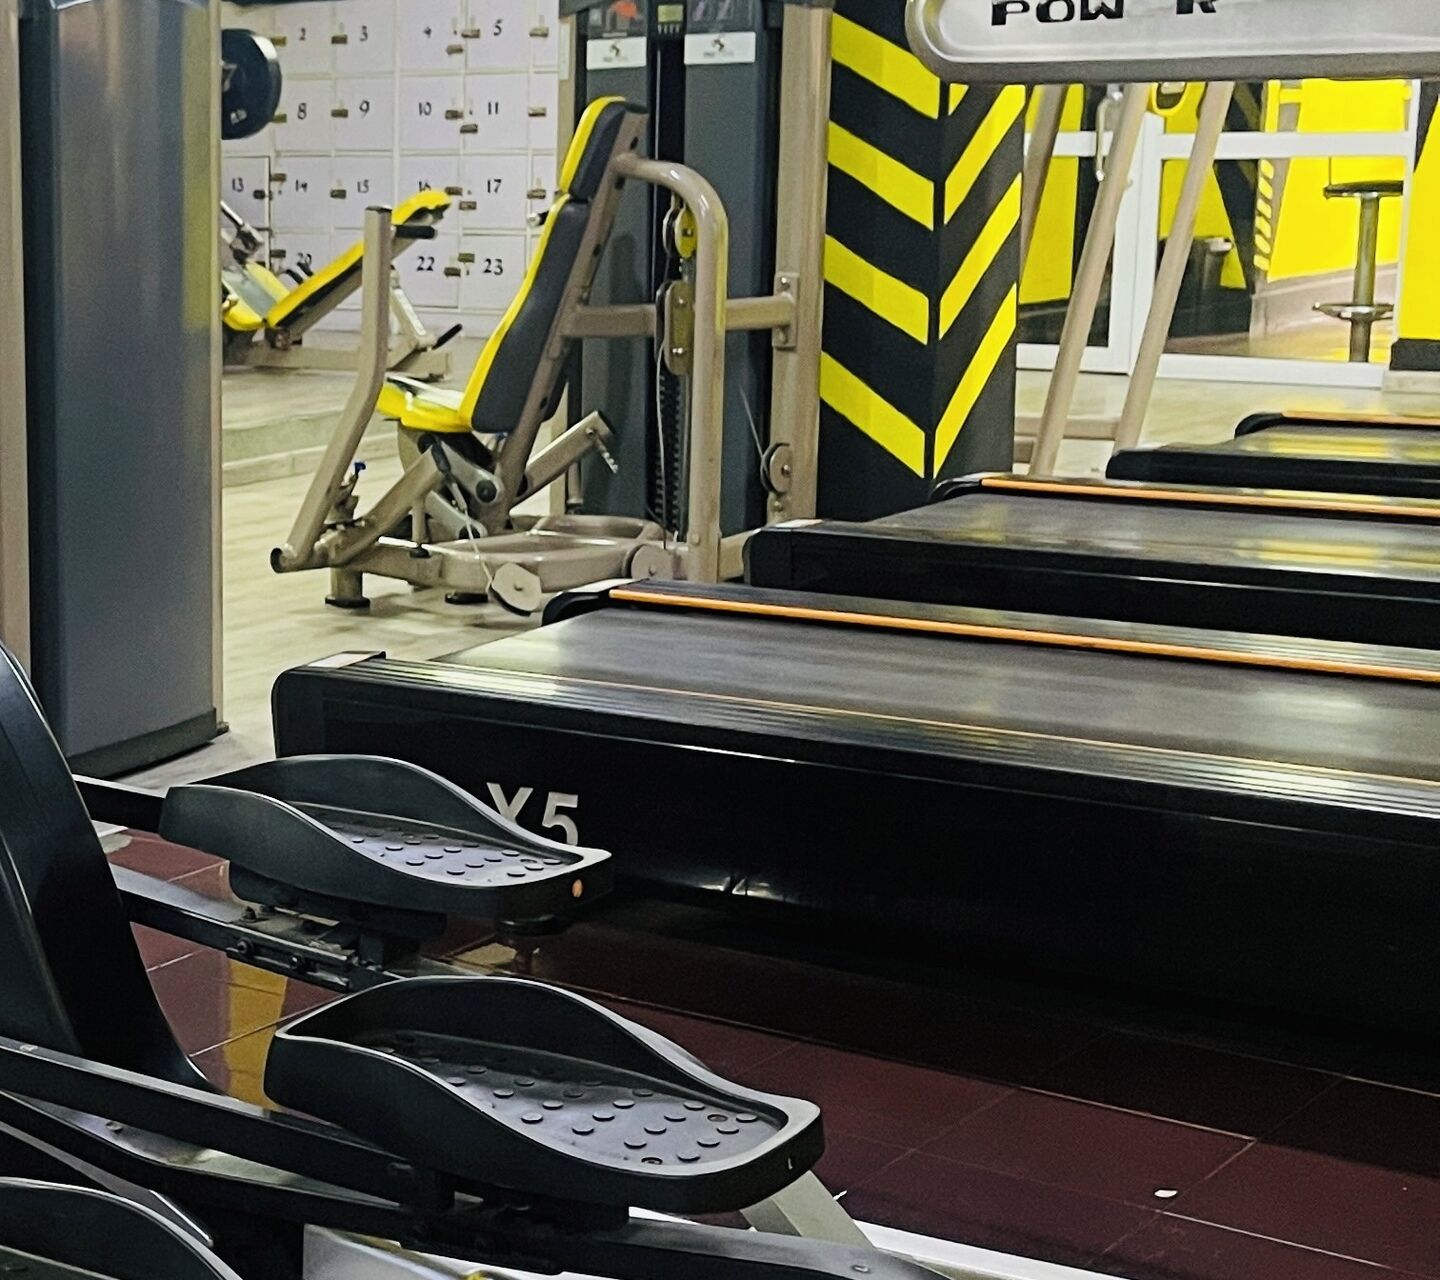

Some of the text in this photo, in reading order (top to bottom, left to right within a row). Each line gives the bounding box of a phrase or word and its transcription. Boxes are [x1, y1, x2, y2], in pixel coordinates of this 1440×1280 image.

[298, 27, 307, 42] 2
[359, 25, 369, 42] 3
[493, 19, 504, 37] 5
[296, 102, 307, 120] 8
[359, 100, 370, 119] 9
[418, 101, 433, 117] 10
[487, 101, 500, 116] 11
[231, 177, 244, 193] 13
[295, 179, 308, 193] 14
[356, 179, 370, 194] 15
[487, 178, 502, 194] 17
[416, 256, 435, 272] 22
[483, 258, 504, 276] 23
